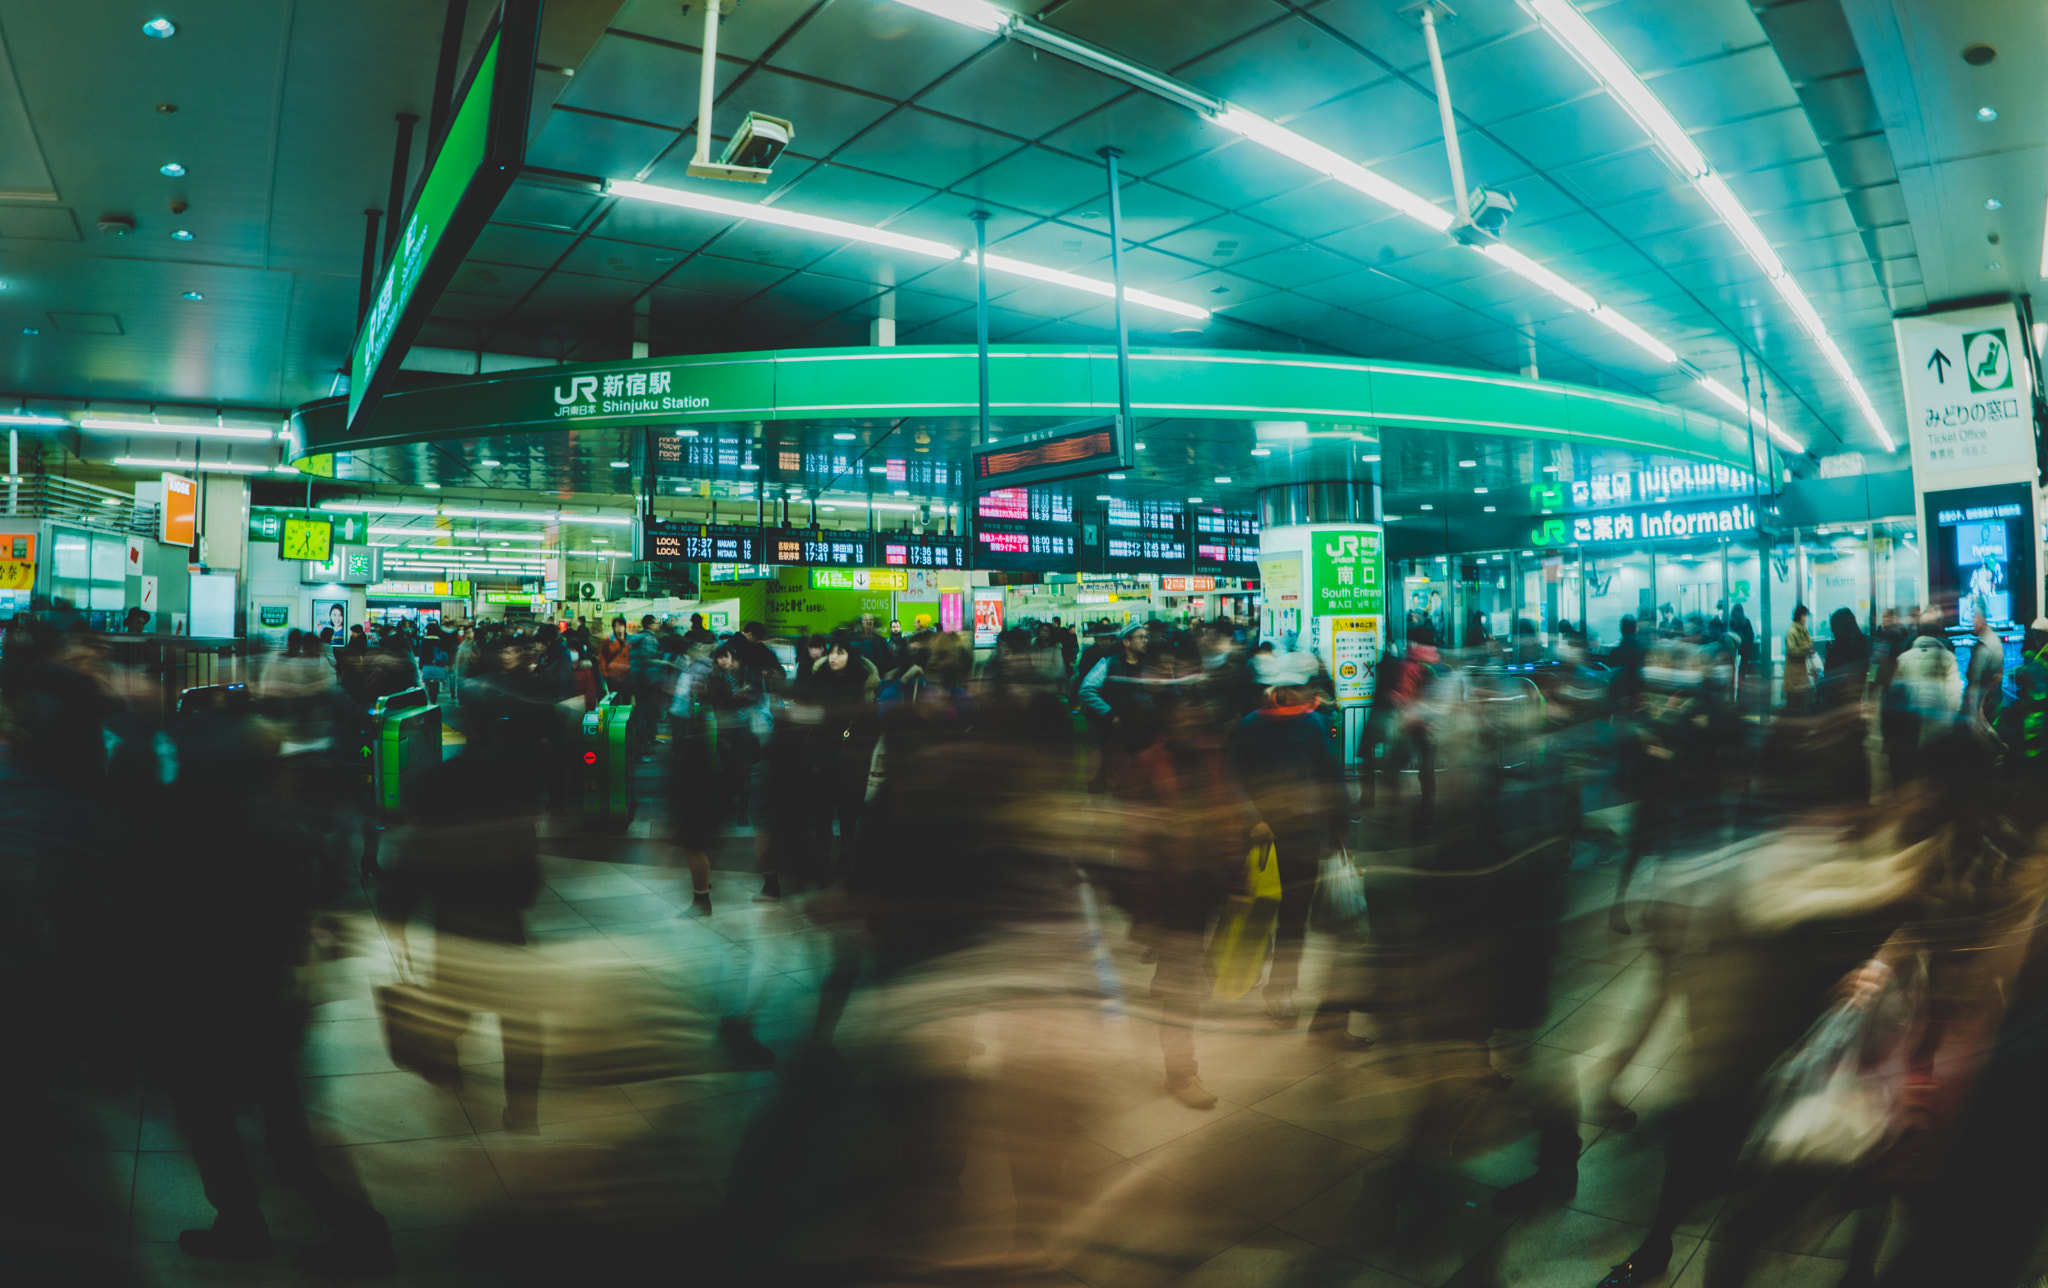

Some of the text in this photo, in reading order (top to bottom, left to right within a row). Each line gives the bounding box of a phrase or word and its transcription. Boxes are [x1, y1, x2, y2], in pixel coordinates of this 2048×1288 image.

[554, 376, 598, 405] JR
[603, 371, 671, 398] 新宿駅
[554, 405, 597, 417] JR東日本
[603, 396, 710, 414] Shinjuku Station
[1926, 399, 2018, 428] みどりの窓口
[1928, 429, 1987, 445] Ticket Office
[169, 480, 190, 496] KIOSK
[1532, 519, 1566, 546] JR
[1573, 514, 1634, 541] ご案内
[656, 537, 751, 550] LOCAL 17:37 NAKANO 16
[1032, 535, 1050, 545] 18:00
[1326, 535, 1359, 557] JR
[656, 547, 680, 556] LOCAL
[686, 547, 712, 558] 17:41
[743, 549, 751, 559] 16
[805, 542, 829, 552] 17:38
[856, 544, 863, 554] 13
[910, 546, 932, 556] 17:36
[955, 547, 963, 557] 12
[1032, 544, 1050, 553] 18:15
[805, 552, 828, 562] 17:41
[856, 554, 863, 563] 13
[910, 555, 932, 565] 17:38
[955, 557, 963, 566] 12
[815, 572, 830, 587] 14
[892, 574, 905, 588] 13
[1337, 565, 1375, 585] 南口
[1164, 578, 1173, 590] 12
[1206, 578, 1214, 590] 11
[1321, 587, 1351, 598] South
[861, 598, 889, 610] 3COINS
[583, 725, 597, 735] IC
